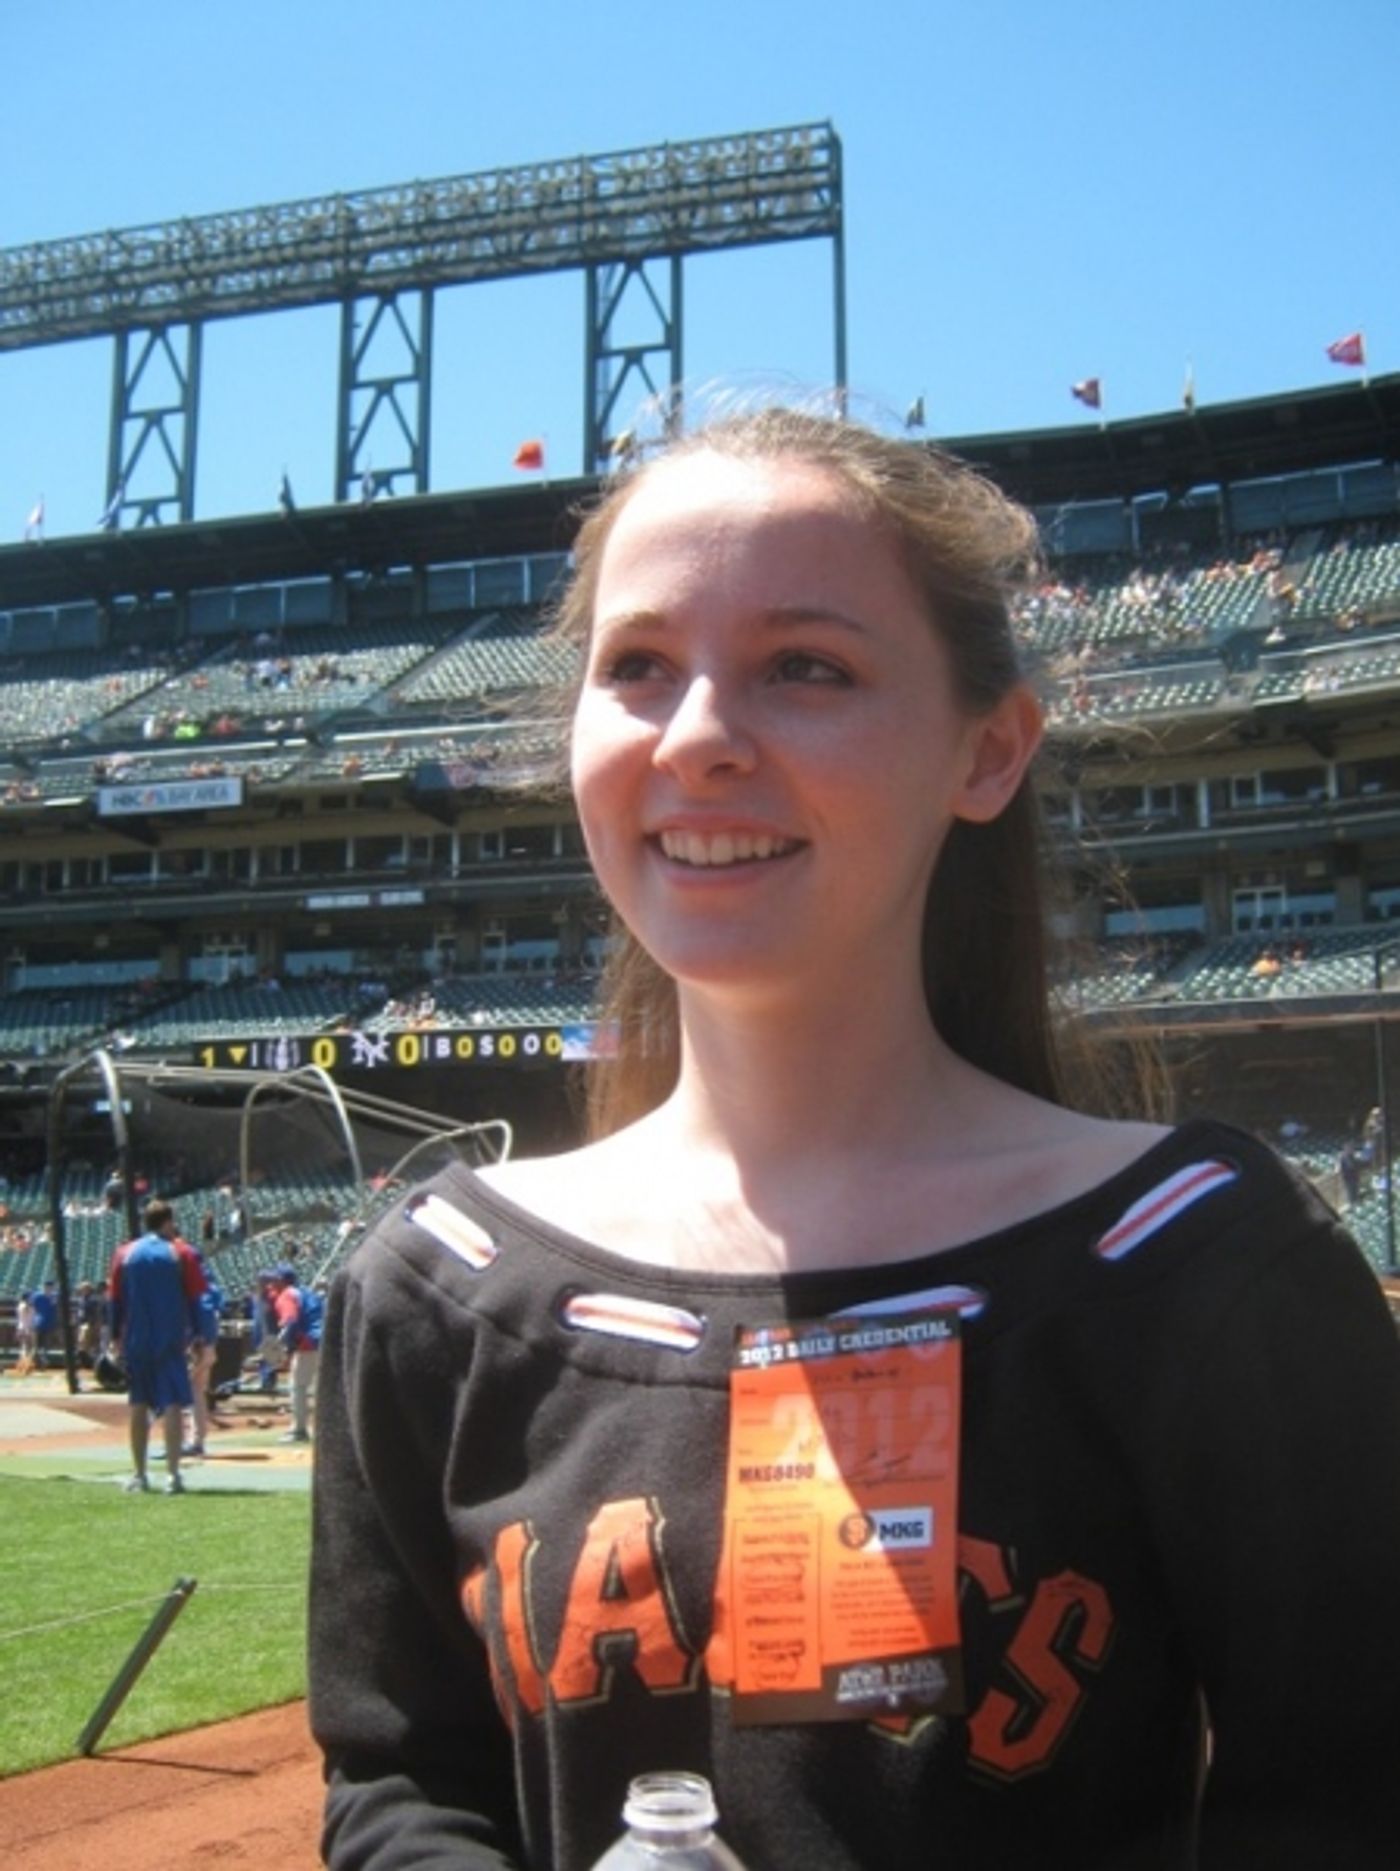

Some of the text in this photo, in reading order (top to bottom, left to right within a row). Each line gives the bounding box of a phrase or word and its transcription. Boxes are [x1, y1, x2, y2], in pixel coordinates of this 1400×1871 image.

[312, 1037, 337, 1068] 0
[397, 1034, 420, 1066] 0
[435, 1036, 451, 1058] B
[480, 1034, 495, 1056] S
[839, 1320, 951, 1350] CREDENTIAL
